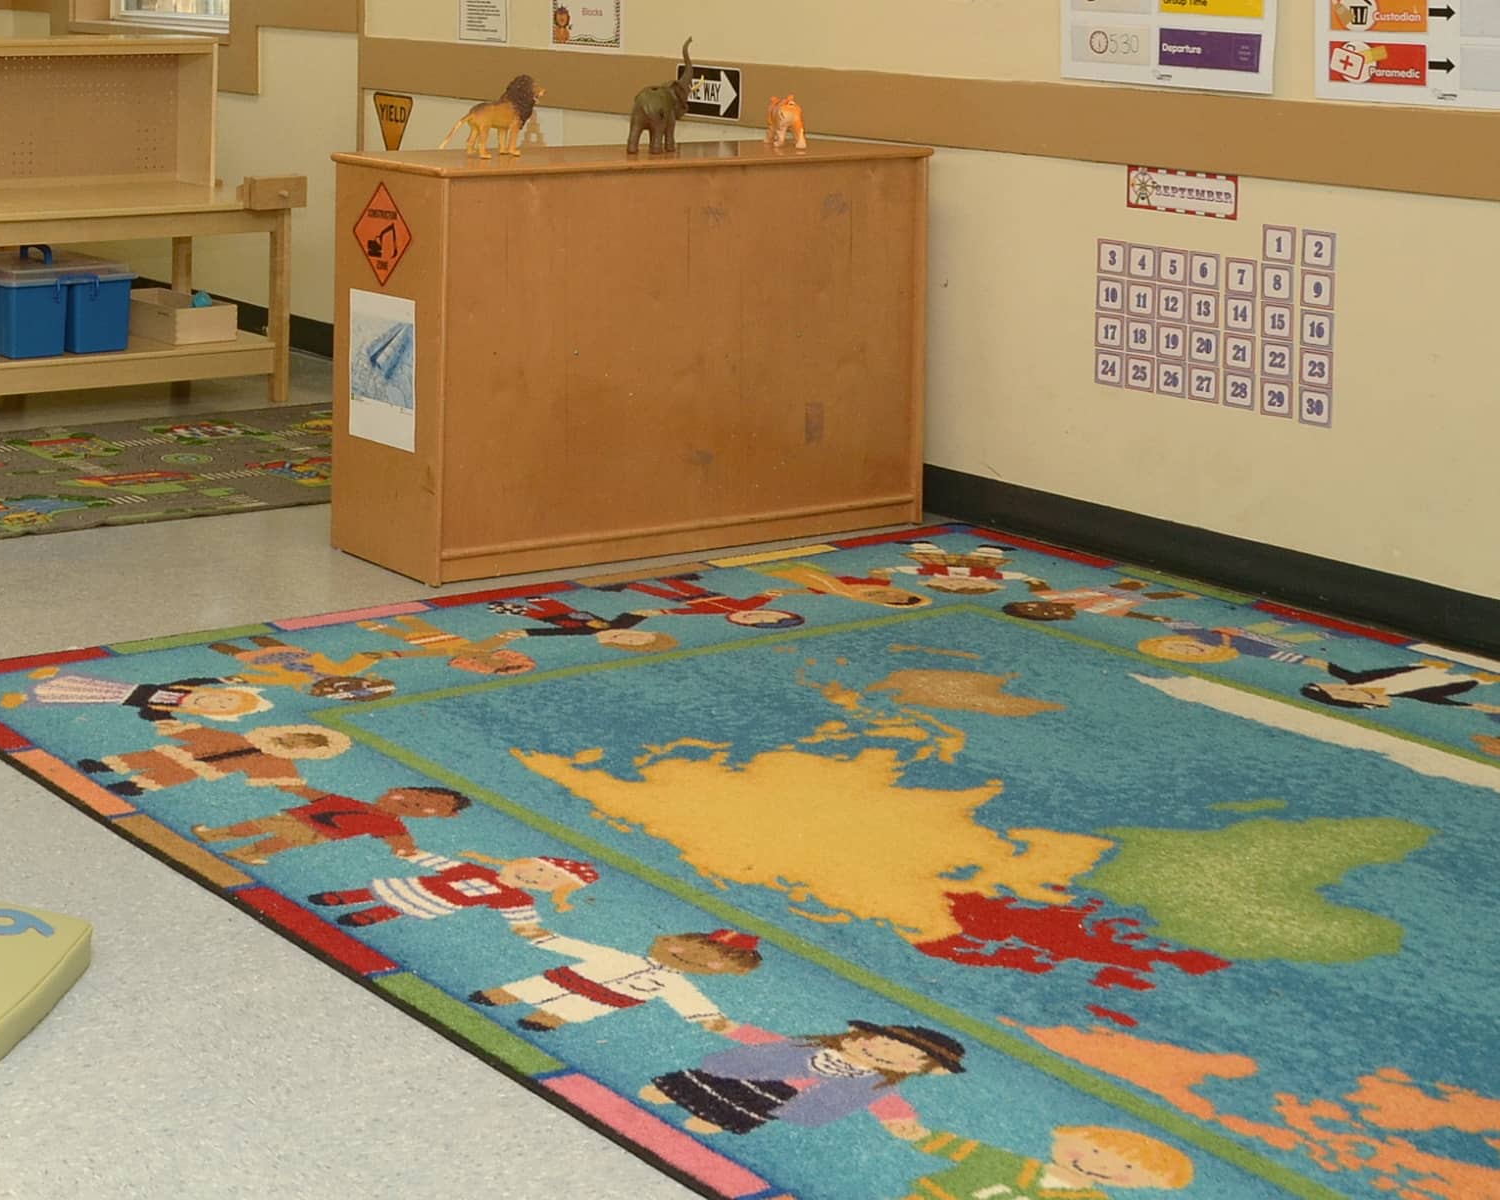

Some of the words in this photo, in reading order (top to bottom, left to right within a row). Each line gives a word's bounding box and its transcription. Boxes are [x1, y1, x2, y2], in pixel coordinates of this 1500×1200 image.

[581, 7, 603, 17] Blocks
[1374, 11, 1421, 23] Custodian
[1162, 43, 1201, 55] Departure
[1369, 67, 1421, 79] Paramedic
[704, 82, 721, 102] WAY
[380, 104, 406, 123] YIELD
[1155, 185, 1233, 204] SEPTEMBER
[1276, 237, 1282, 252] 1
[1314, 241, 1323, 258] 2
[1109, 250, 1116, 266] 3
[1138, 254, 1146, 270] 4
[1169, 259, 1177, 275] 5
[1200, 262, 1208, 278] 6
[1237, 268, 1245, 285] 7
[1273, 274, 1281, 291] 8
[1314, 281, 1322, 298] 9
[1104, 286, 1117, 302] 10
[1136, 292, 1147, 309] 11
[1164, 296, 1178, 312] 12
[1196, 300, 1211, 317] 13
[1233, 305, 1247, 321] 14
[1270, 313, 1285, 330] 15
[1309, 321, 1324, 338] 16
[1104, 324, 1116, 340] 17
[1133, 328, 1147, 344] 18
[1165, 333, 1179, 349] 19
[1196, 338, 1212, 354] 20
[1232, 345, 1247, 362] 21
[1269, 351, 1286, 369] 22
[1308, 360, 1325, 378] 23
[1101, 360, 1116, 376] 24
[1132, 365, 1147, 382] 25
[1164, 371, 1179, 387] 26
[1196, 375, 1211, 392] 27
[1231, 382, 1247, 398] 28
[1268, 390, 1284, 407] 29
[1306, 398, 1323, 416] 30
